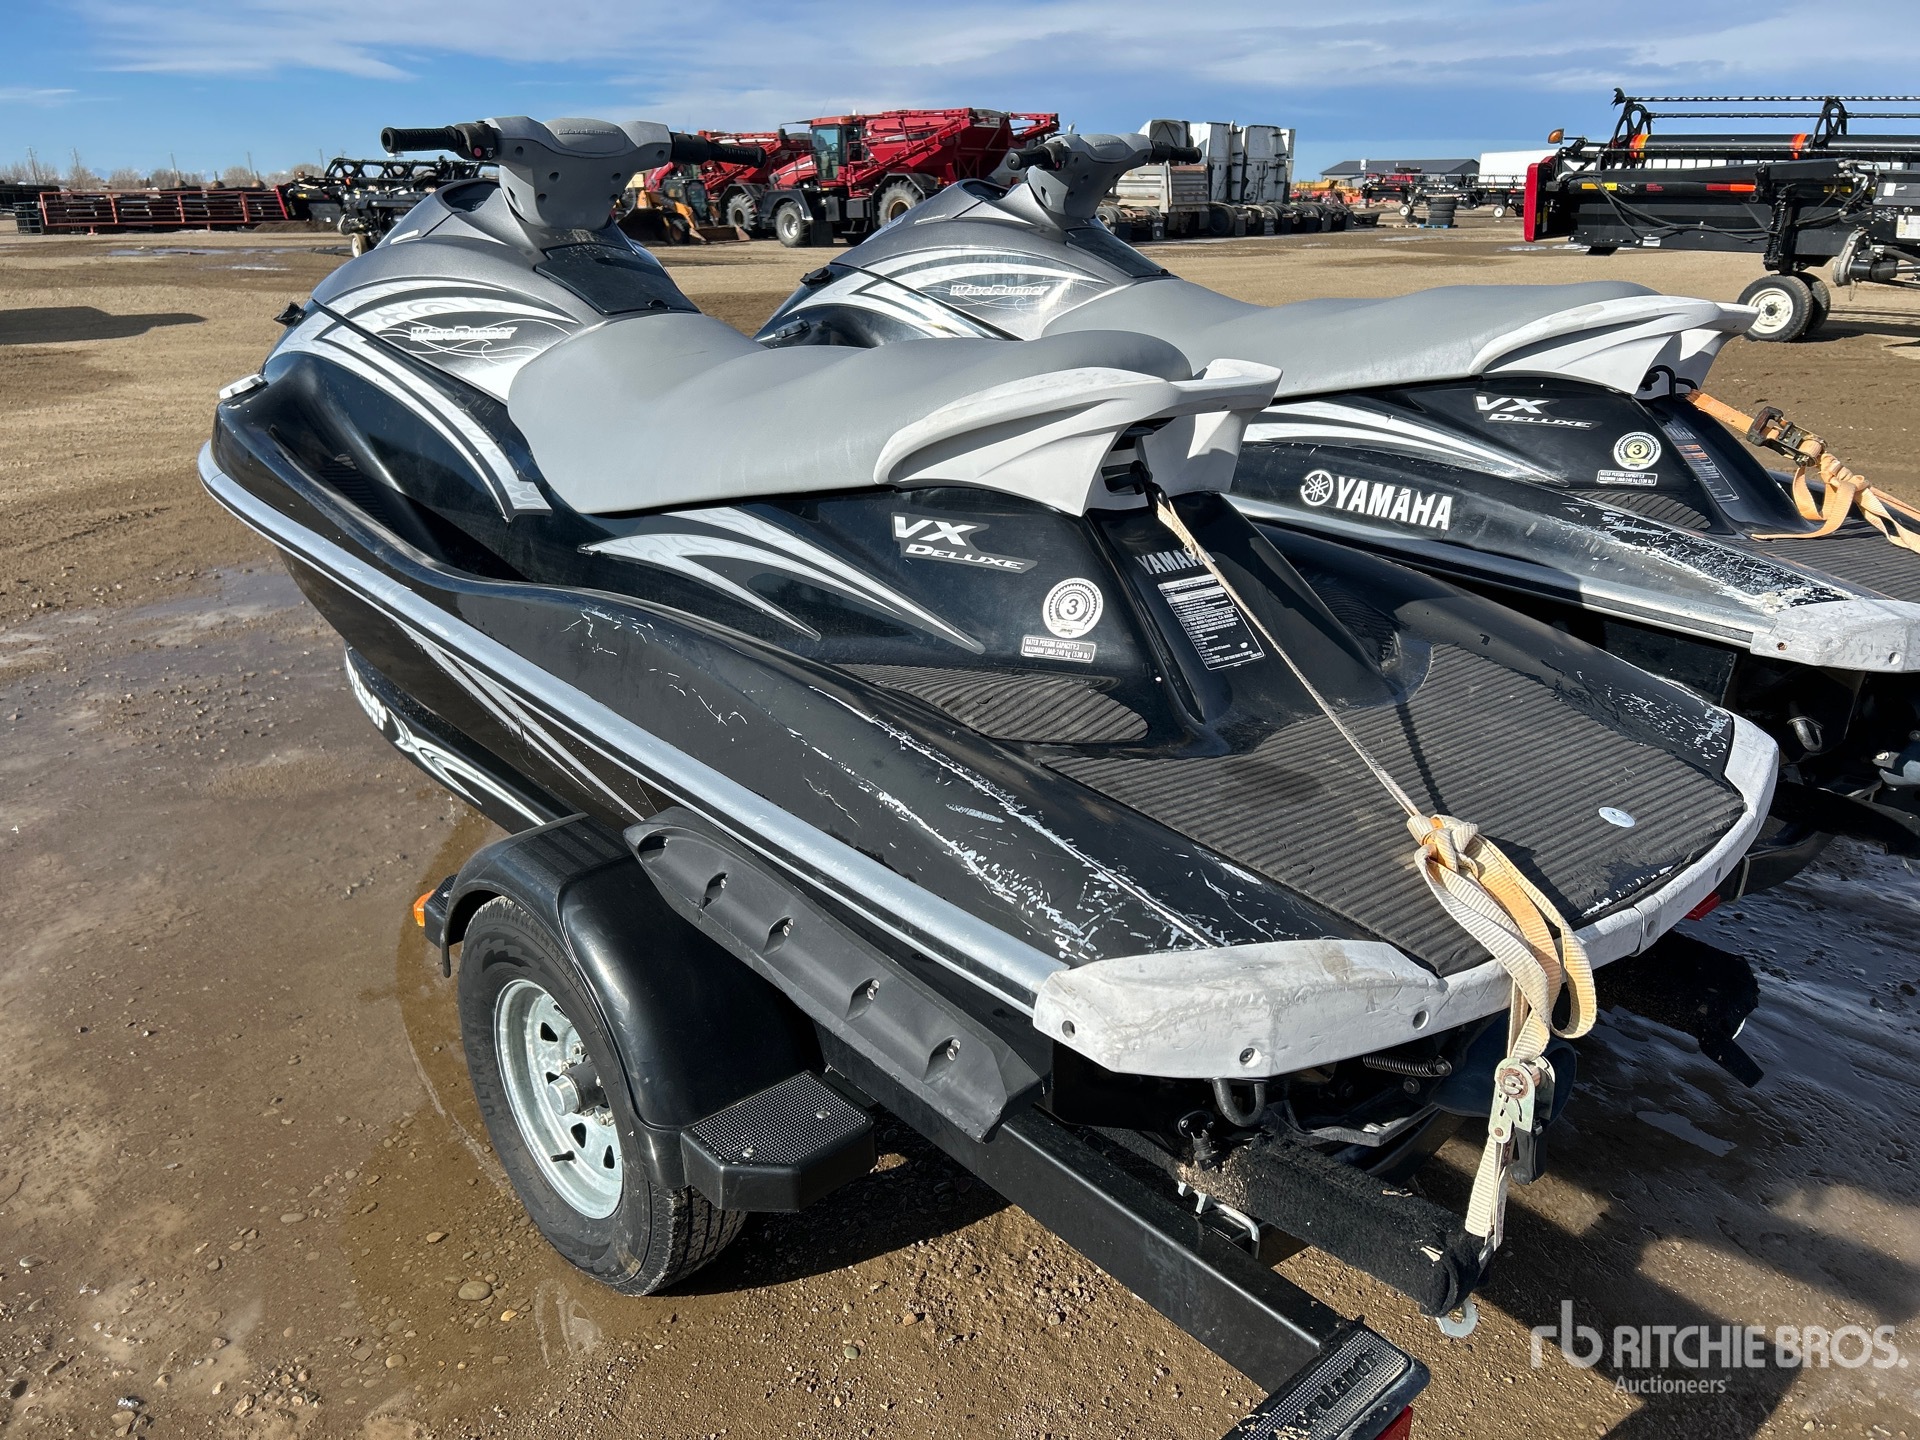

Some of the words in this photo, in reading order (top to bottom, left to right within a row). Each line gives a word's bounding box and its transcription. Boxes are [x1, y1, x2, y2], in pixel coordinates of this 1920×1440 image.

[950, 285, 1050, 296] WaveRunner
[1476, 396, 1549, 414] VX
[1632, 444, 1643, 455] 3
[1336, 476, 1452, 531] YAMAHA
[894, 515, 978, 547] VX
[1066, 598, 1079, 615] 3
